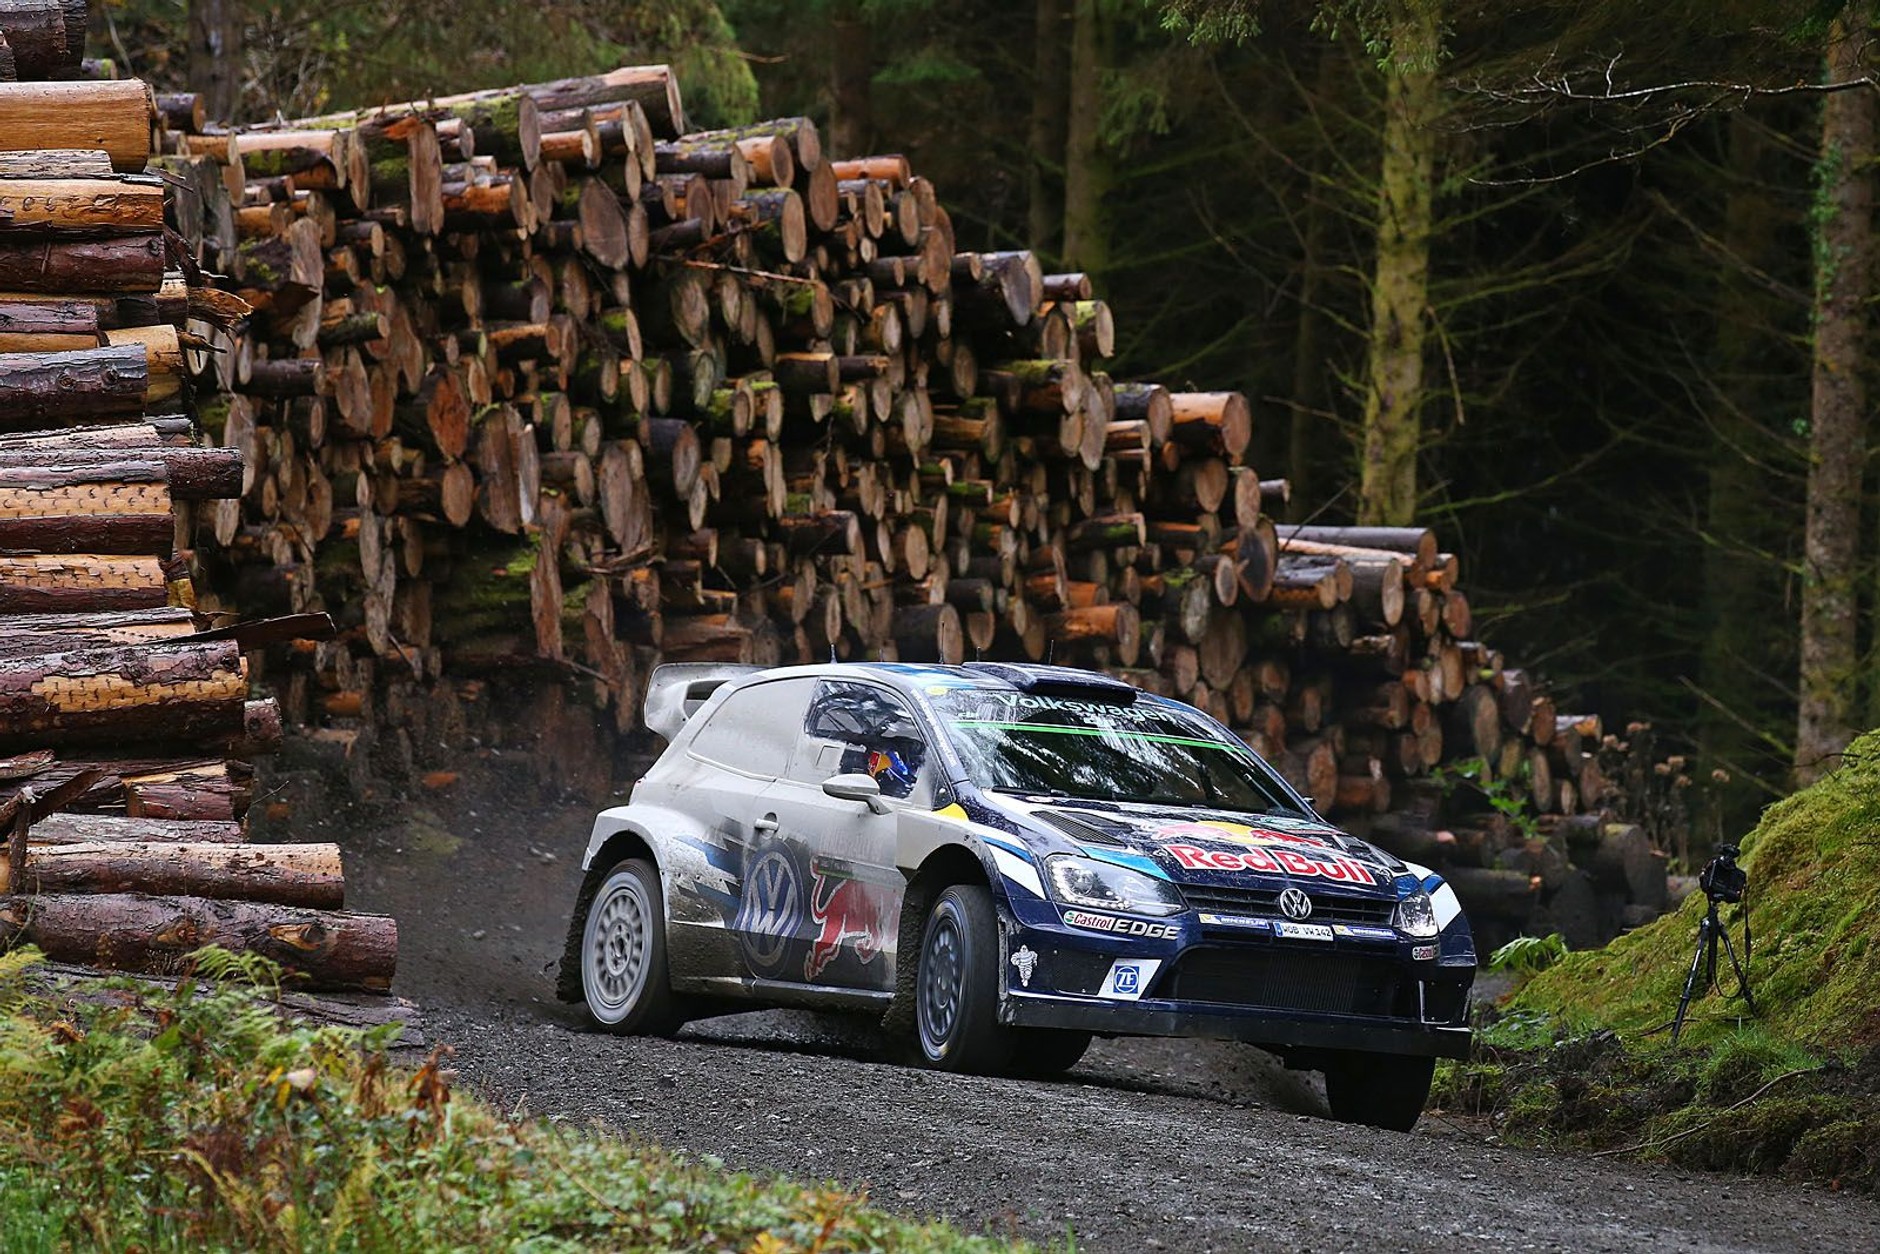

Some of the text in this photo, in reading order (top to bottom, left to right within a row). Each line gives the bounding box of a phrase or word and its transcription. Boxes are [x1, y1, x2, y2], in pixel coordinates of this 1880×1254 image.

[996, 692, 1180, 724] Volkswagen
[1166, 844, 1376, 885] Red Bull
[1074, 913, 1182, 940] Castrol EDGE
[1117, 971, 1135, 988] ZF
